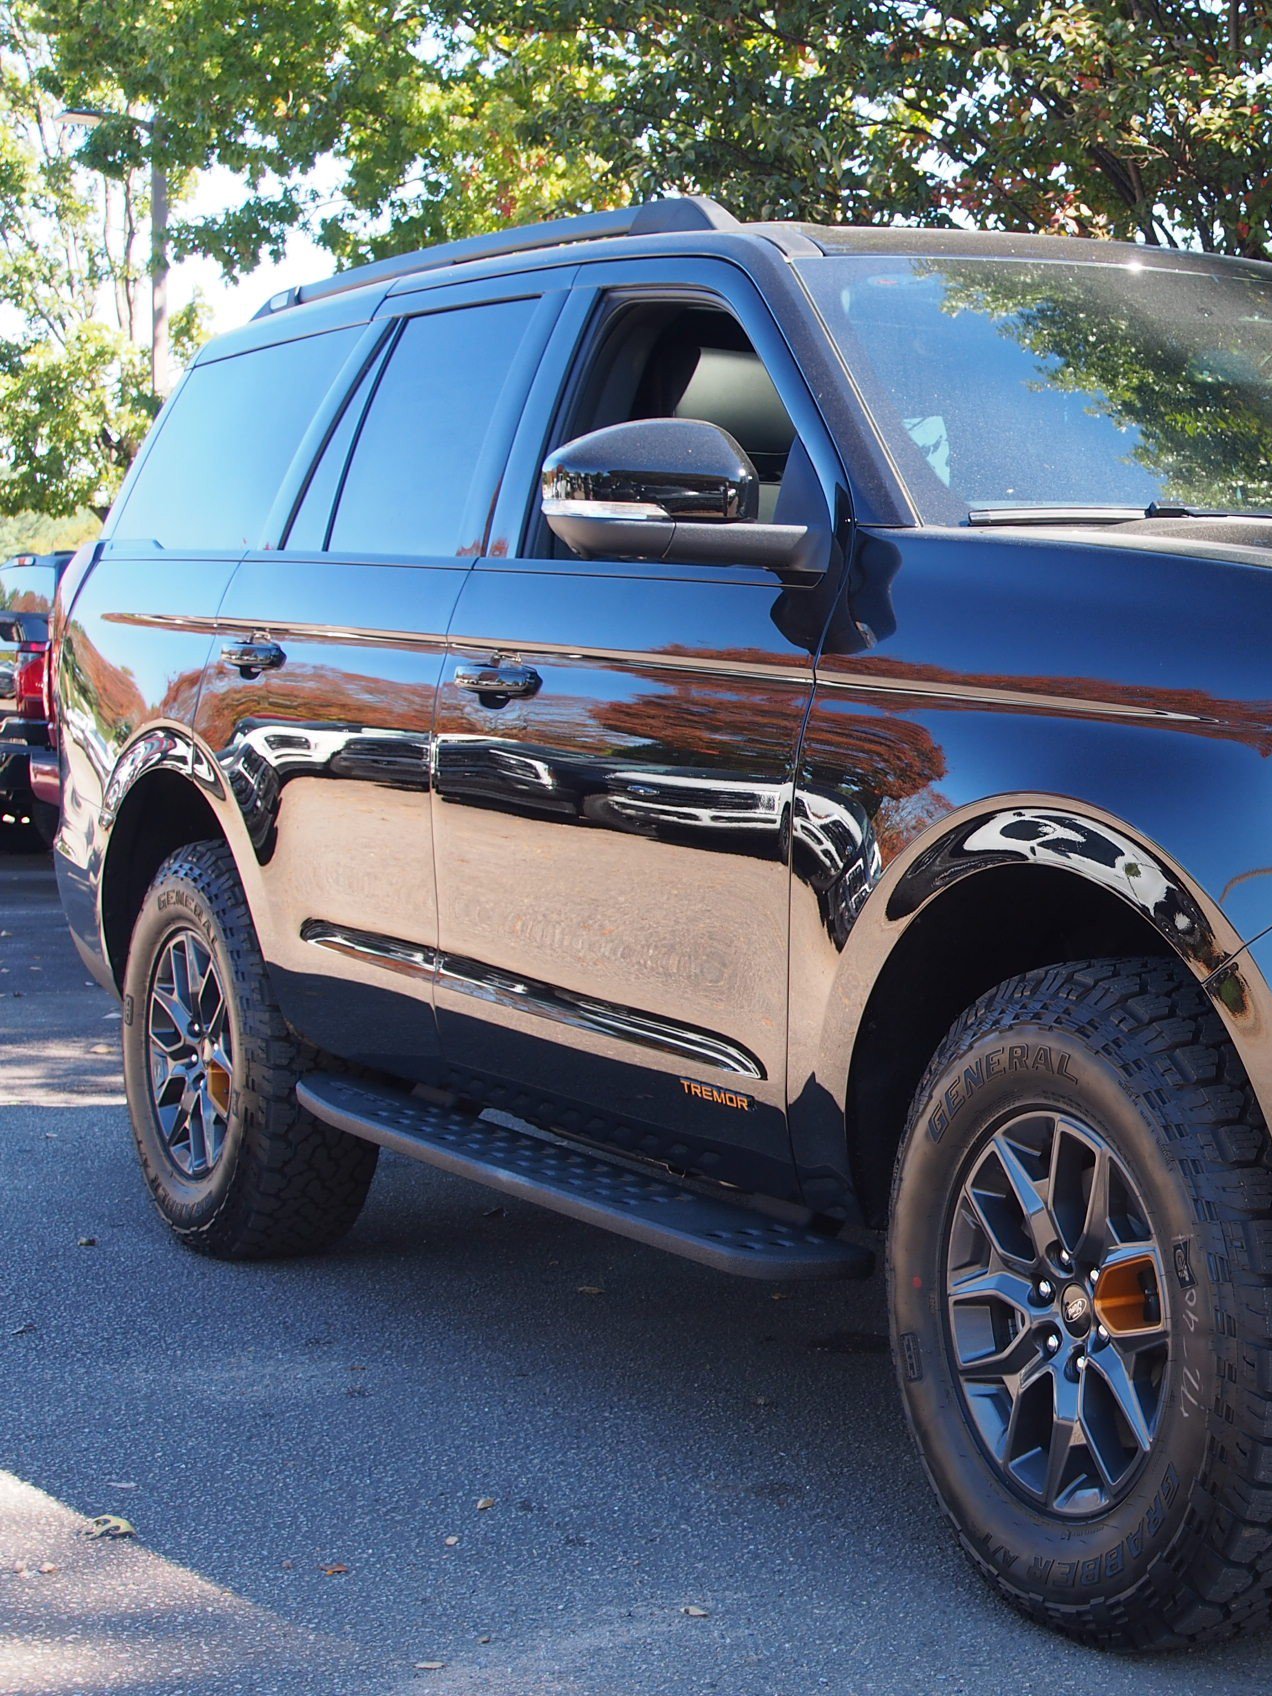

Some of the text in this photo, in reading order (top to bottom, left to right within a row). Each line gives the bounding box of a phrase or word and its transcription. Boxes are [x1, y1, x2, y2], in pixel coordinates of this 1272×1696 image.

[157, 889, 218, 959] GENERAL
[681, 1081, 748, 1111] TREMOR
[927, 1043, 1079, 1145] GENERAL
[1026, 1463, 1181, 1588] GRABBER
